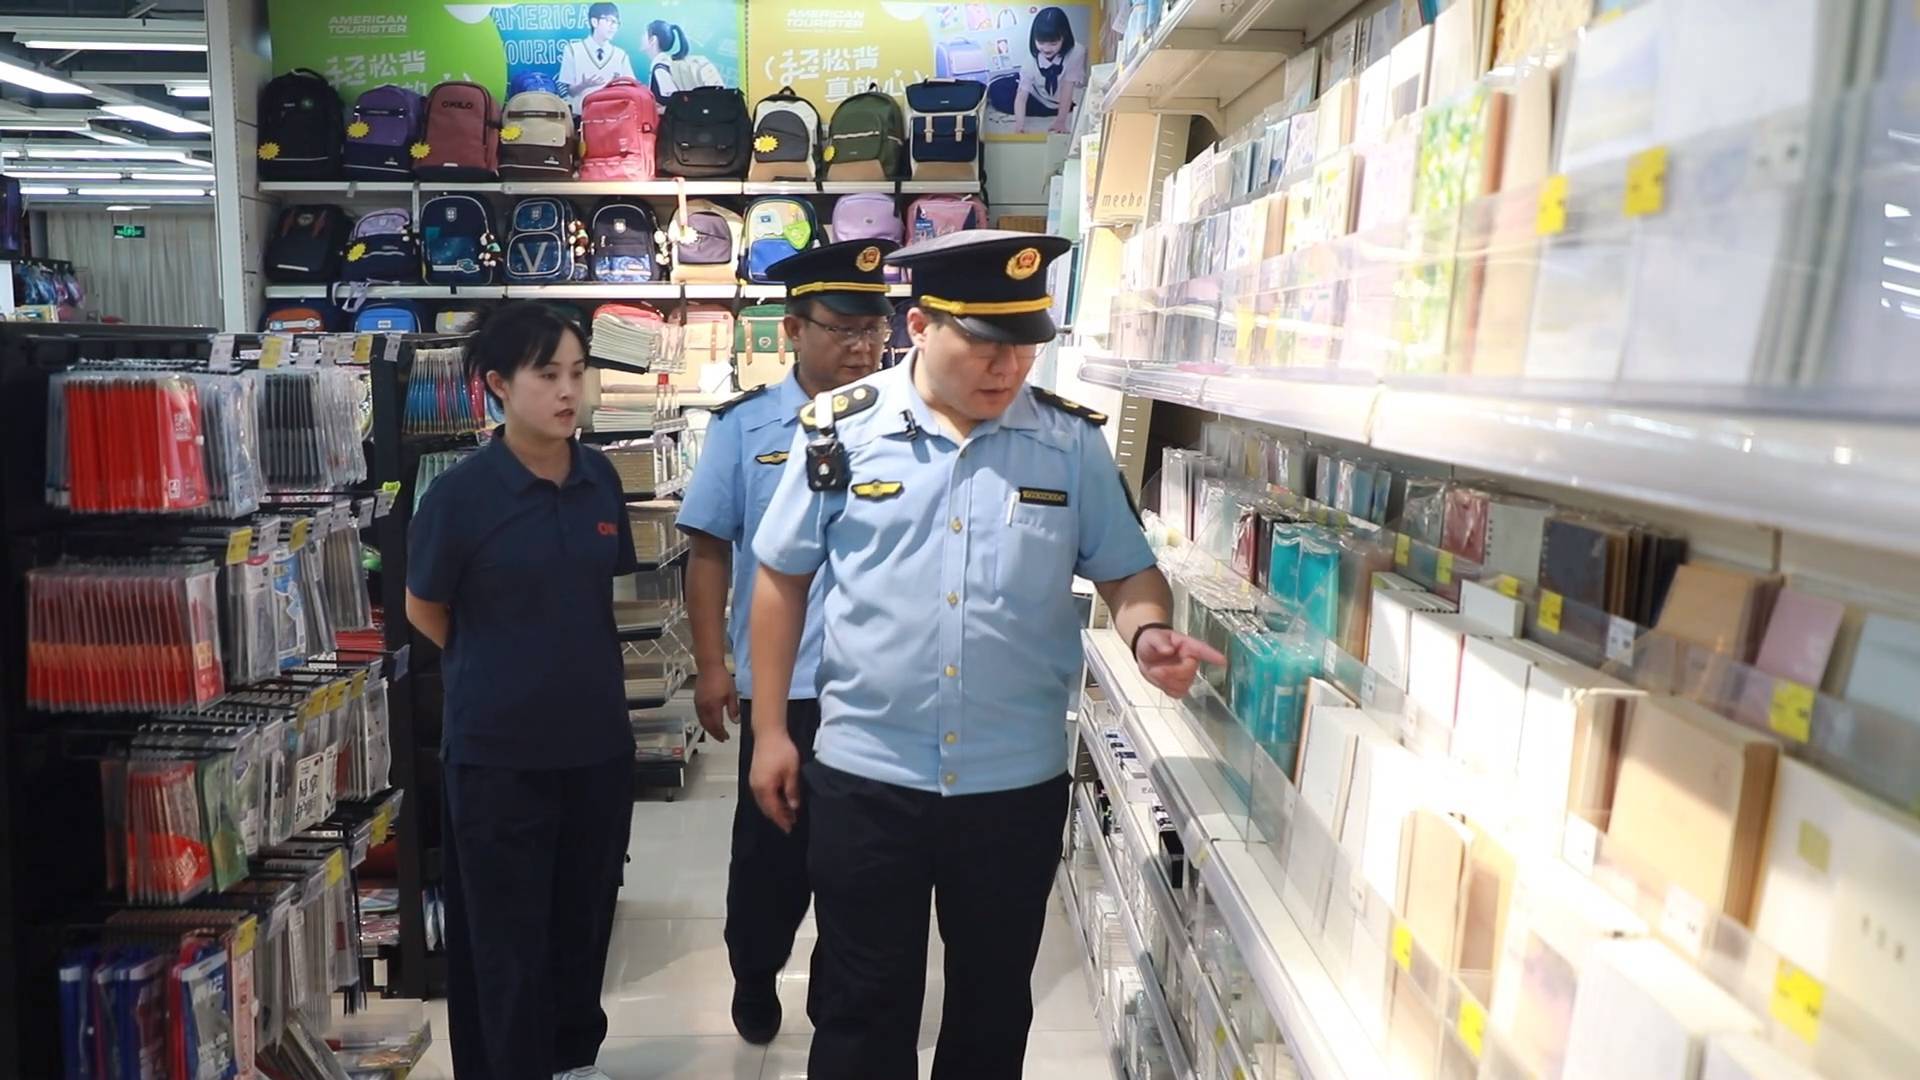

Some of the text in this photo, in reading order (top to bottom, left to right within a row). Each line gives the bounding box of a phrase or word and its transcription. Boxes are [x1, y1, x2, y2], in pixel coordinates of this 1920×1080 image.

[787, 9, 865, 19] AMERICAN
[329, 15, 408, 25] AMERICAN
[786, 18, 864, 28] TOURISTER
[328, 24, 407, 34] TOURISTER
